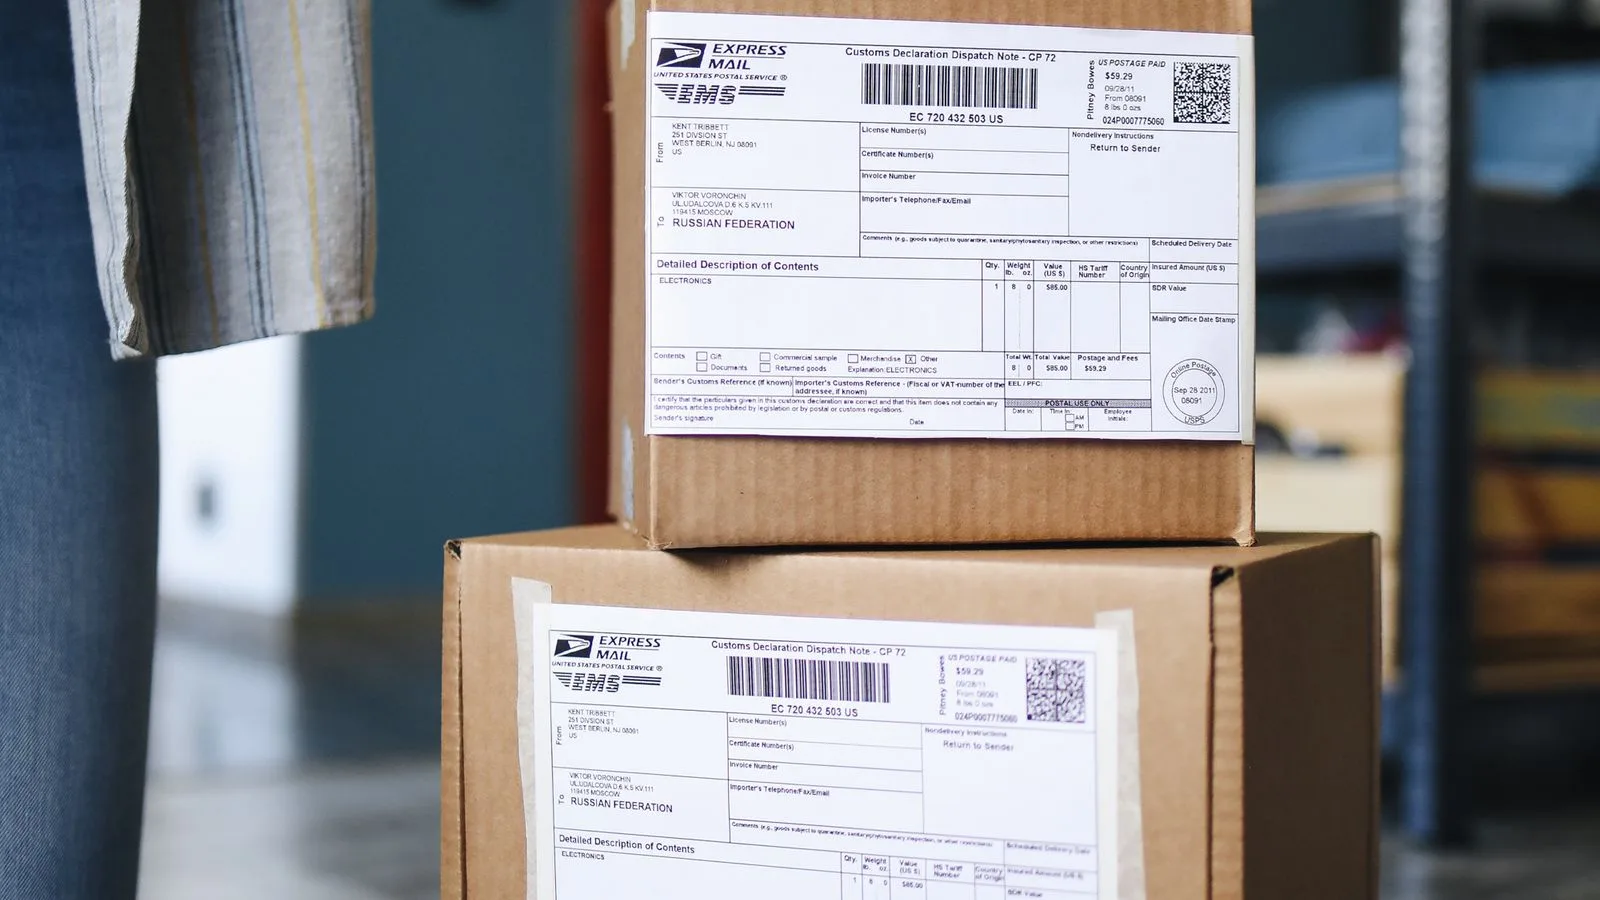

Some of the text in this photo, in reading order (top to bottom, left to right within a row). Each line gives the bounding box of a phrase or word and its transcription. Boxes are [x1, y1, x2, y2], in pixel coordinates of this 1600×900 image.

[712, 44, 787, 55] EXPRESS
[845, 47, 889, 57] Customs
[893, 49, 949, 59] Declaration
[952, 50, 994, 60] Dispatch
[998, 52, 1019, 60] Note
[1028, 53, 1042, 61] CP
[1045, 53, 1056, 62] 72
[708, 59, 751, 70] MAIL
[1105, 72, 1133, 80] $59.29
[1087, 92, 1096, 120] Pitney
[910, 112, 1003, 123] EC 720 432 503 US
[1102, 117, 1164, 125] 024P0007775060
[1072, 132, 1112, 140] Nondelivery
[1090, 144, 1118, 152] Return
[898, 152, 934, 160] Number(s)
[862, 196, 971, 205] Importer's Telephone/Fax/Email
[658, 217, 664, 226] To
[673, 218, 795, 229] RUSSIAN FEDERATION
[1188, 241, 1215, 249] Delivery
[657, 260, 819, 271] Detailed Description of Contents
[985, 262, 999, 270] Qty.
[1007, 262, 1031, 270] Weight
[1120, 264, 1148, 273] Country
[1206, 264, 1216, 272] (US
[1218, 264, 1225, 272] $)
[1044, 270, 1065, 278] (US $)
[1152, 315, 1176, 323] Mailing
[1171, 362, 1216, 378] Online Postage
[600, 636, 661, 647] EXPRESS
[712, 641, 750, 650] Customs
[754, 642, 804, 652] Declaration
[807, 645, 846, 654] Dispatch
[850, 647, 870, 655] Note
[596, 650, 631, 660] MAIL
[939, 688, 947, 715] Pitney
[771, 704, 858, 717] EC 720 432 503 US
[755, 719, 787, 727] Number(s)
[762, 742, 794, 750] Number(s)
[593, 774, 631, 782] VORONCHIN
[559, 795, 564, 804] To
[571, 797, 673, 812] RUSSIAN FEDERATION
[559, 835, 592, 845] Detailed
[595, 838, 642, 849] Description
[656, 844, 695, 854] Contents
[562, 851, 604, 860] ELECTRONICS
